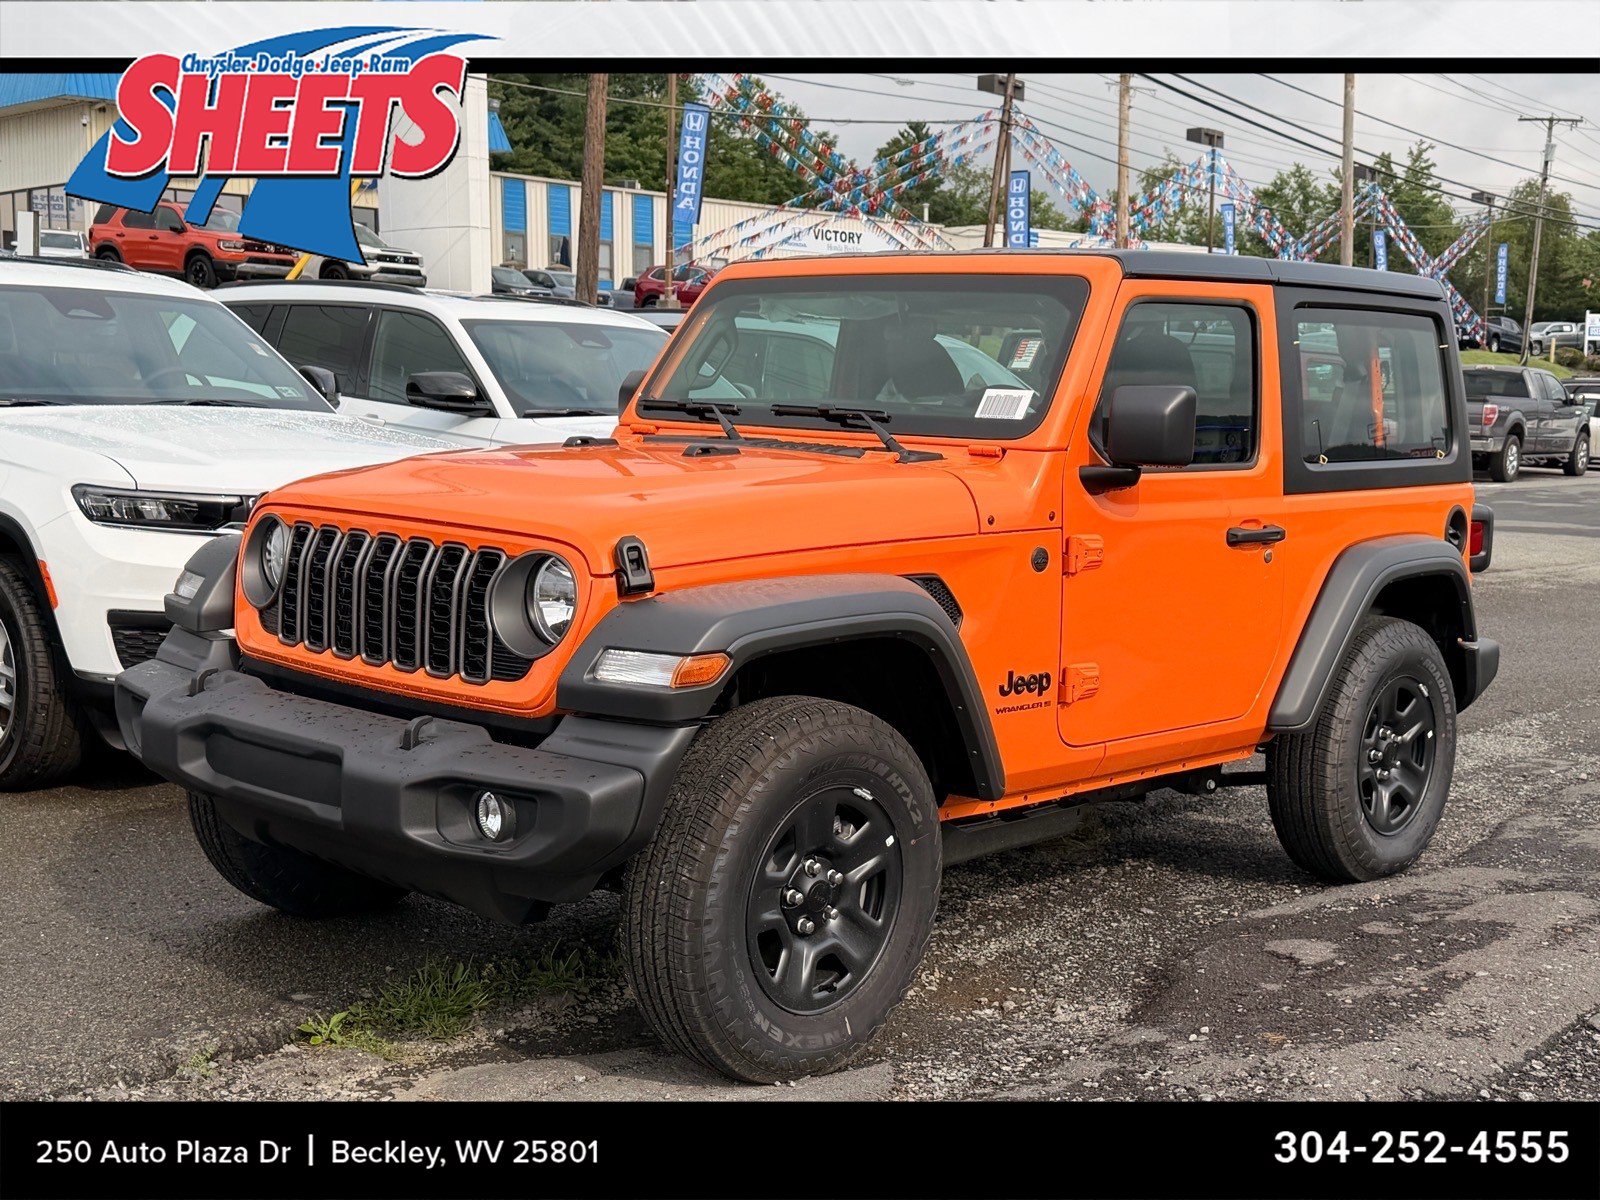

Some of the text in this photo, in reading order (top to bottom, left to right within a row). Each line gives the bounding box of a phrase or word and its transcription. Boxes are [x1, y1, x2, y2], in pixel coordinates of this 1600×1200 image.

[813, 228, 863, 244] VICTORY
[998, 670, 1052, 698] Jeep
[995, 701, 1043, 715] WRANGLER
